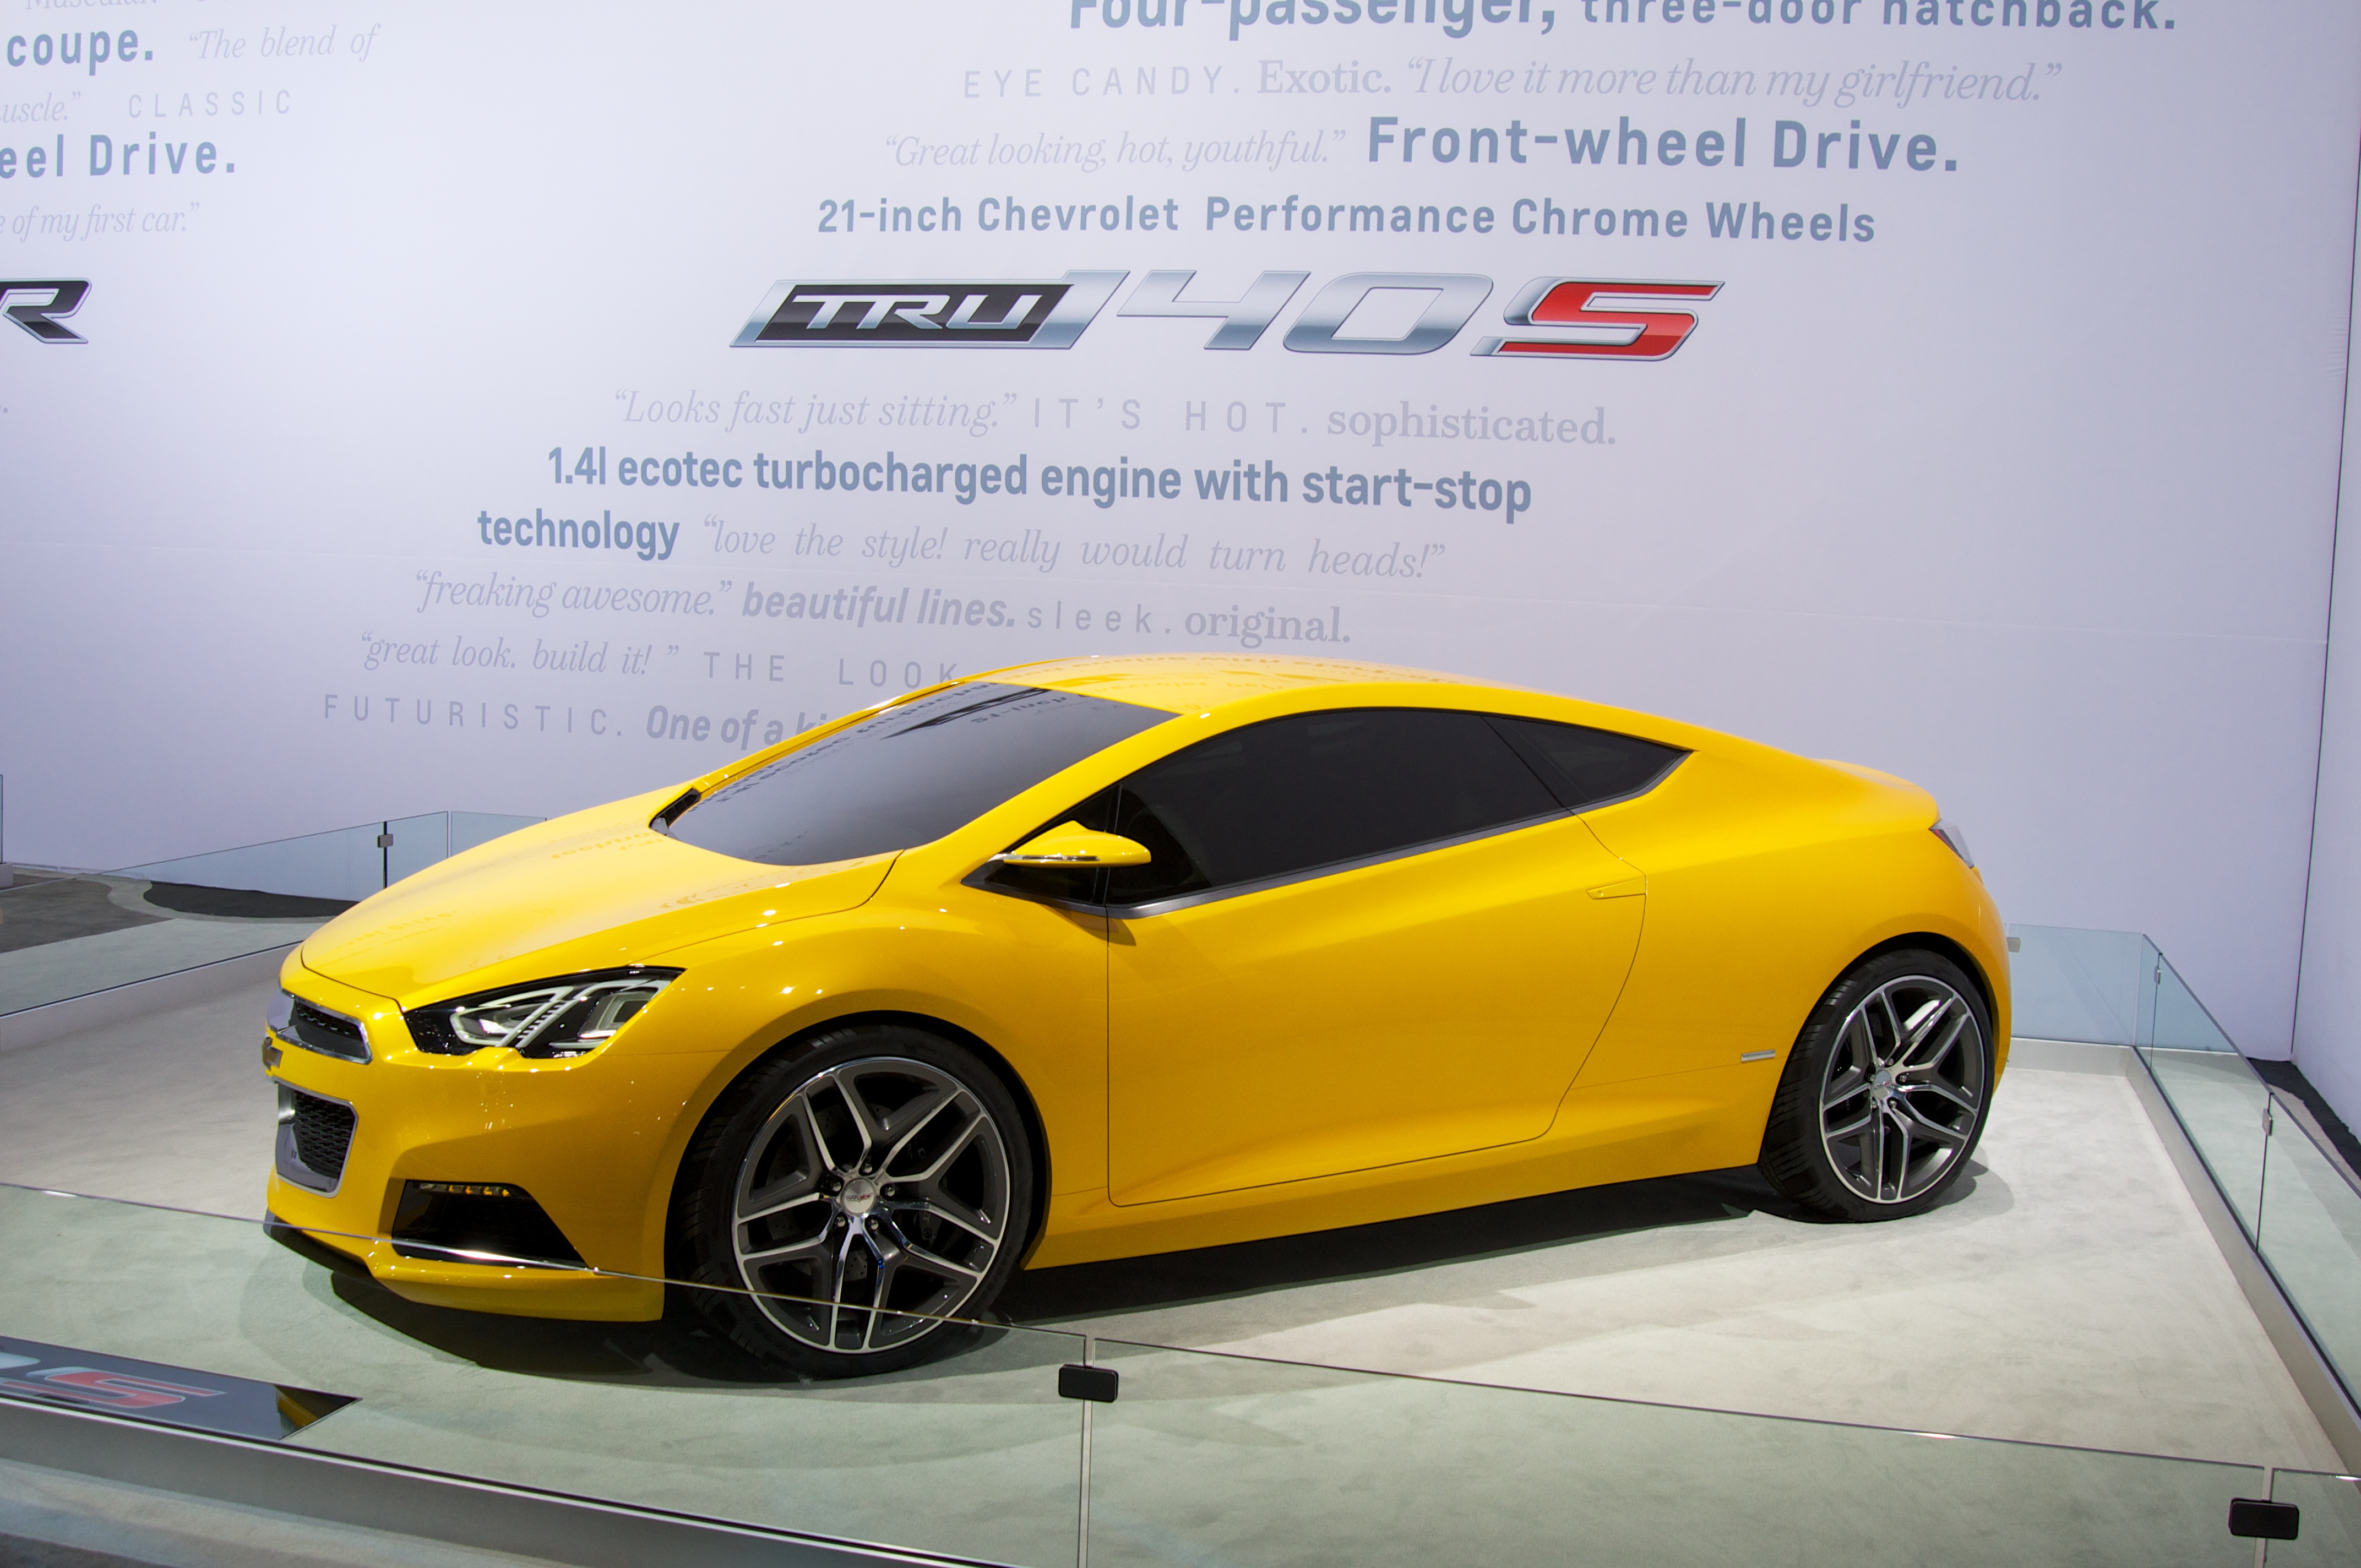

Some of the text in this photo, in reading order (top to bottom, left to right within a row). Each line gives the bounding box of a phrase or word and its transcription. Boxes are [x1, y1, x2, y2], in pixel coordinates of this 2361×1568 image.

[1070, 0, 1555, 42] Four-passenger,
[6, 23, 381, 77] coupe. “The blend of
[0, 90, 290, 123] uscle.” CLASSIC
[964, 57, 2062, 109] EYE CANDY. Exotic. “I love it more than my girlfriend.”
[89, 130, 235, 177] Drive.
[886, 115, 1957, 173] “Great looking, hot, youthful.” Front-wheel Drive.
[13, 205, 39, 242] of
[41, 214, 79, 242] my
[80, 204, 135, 241] first
[142, 202, 199, 232] car.”
[818, 194, 1875, 243] 21-inch Chevrolet Performance Chrome Wheels
[616, 389, 1615, 447] “Looks fast just sitting.” IT’S HOT. sophisticated.
[618, 451, 743, 488] ecotec
[753, 449, 1027, 506] turbocharged
[1041, 455, 1182, 510] engine
[1194, 459, 1288, 503] with
[1302, 465, 1532, 525] start-stop
[477, 508, 1445, 578] technology “love the style! really would turn heads!”
[416, 570, 1351, 649] “freaking awesome.” beautiful lines. sleek. original.
[362, 631, 439, 671] “great
[452, 635, 515, 668] look.
[533, 639, 608, 673] build
[704, 652, 785, 682] THE
[839, 658, 957, 689] LOOK
[325, 694, 622, 736] FUTURISTIC.
[646, 705, 711, 742] One
[721, 709, 759, 750] of
